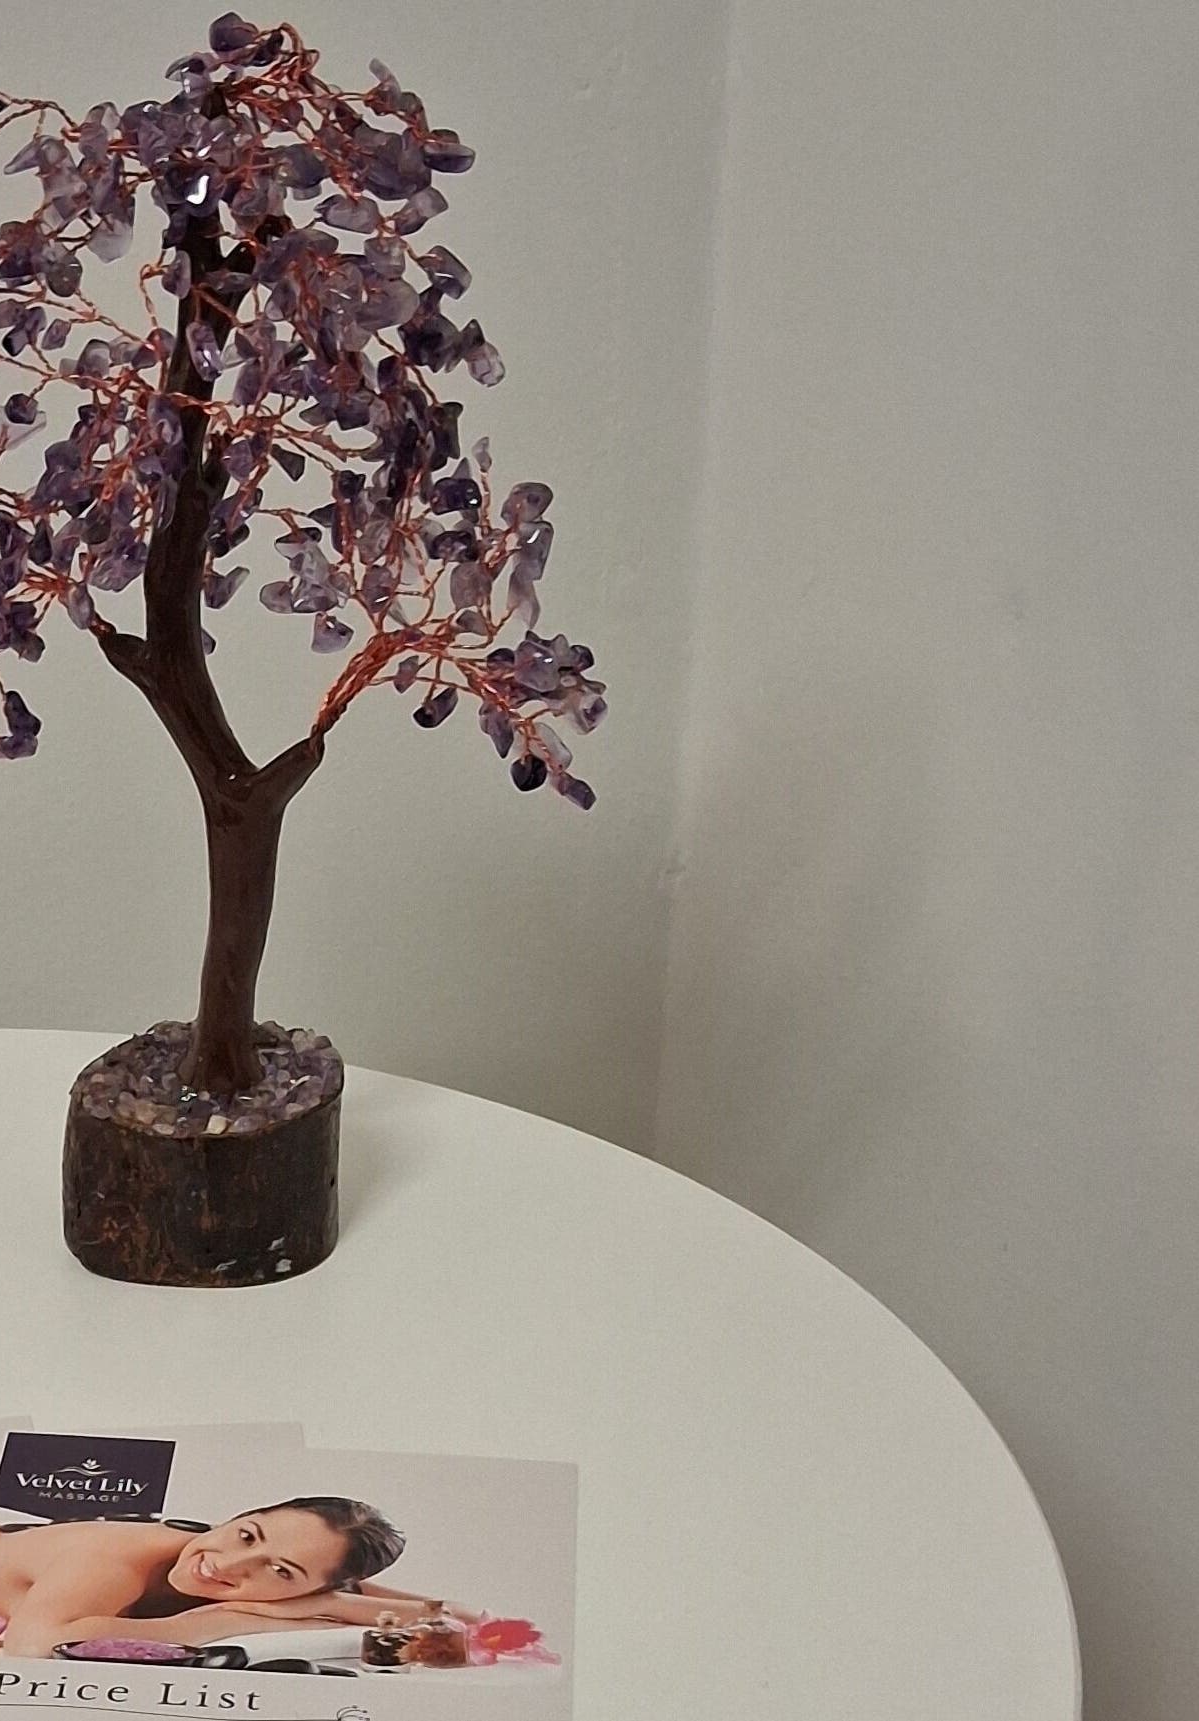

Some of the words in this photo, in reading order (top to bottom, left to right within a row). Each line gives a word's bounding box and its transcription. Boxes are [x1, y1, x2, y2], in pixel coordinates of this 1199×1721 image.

[16, 1472, 92, 1491] Velvet
[99, 1478, 150, 1497] Lily
[38, 1491, 121, 1503] MASSAGE
[158, 1682, 263, 1712] List
